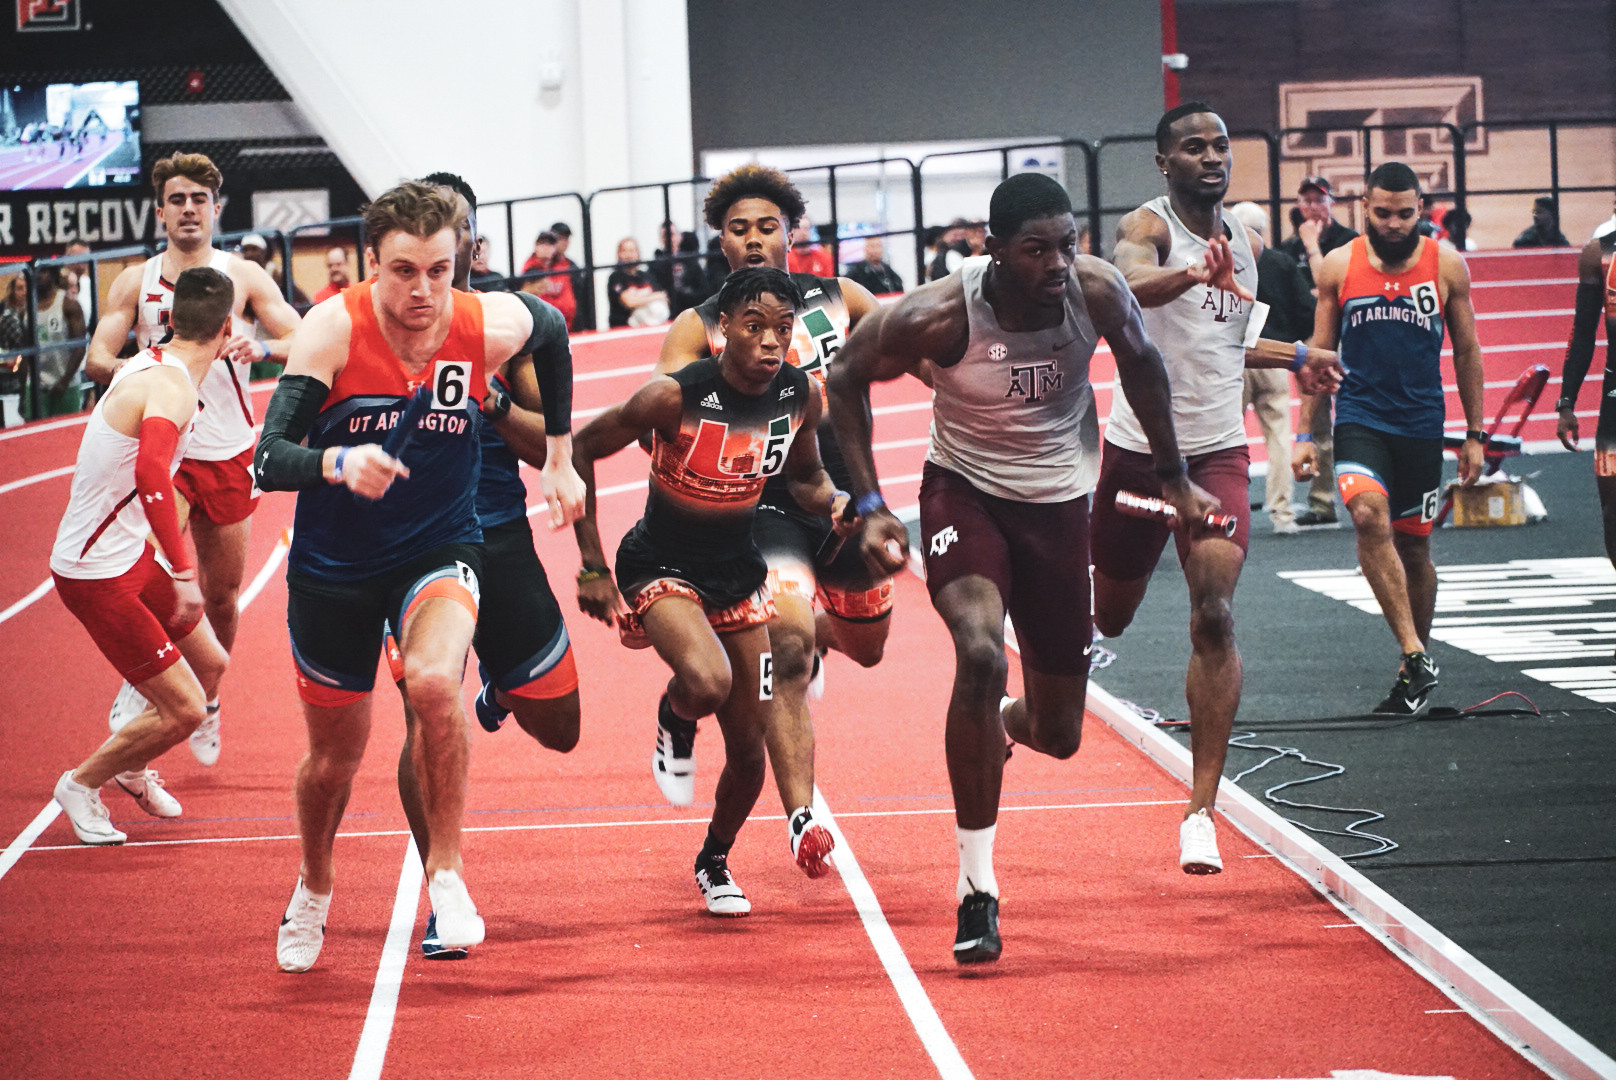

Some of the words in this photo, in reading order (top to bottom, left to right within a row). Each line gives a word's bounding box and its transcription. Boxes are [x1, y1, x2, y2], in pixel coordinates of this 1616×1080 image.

[27, 197, 228, 245] RECOV
[1417, 285, 1436, 315] 6
[1351, 310, 1363, 328] UT
[1365, 306, 1431, 332] ARLINGTON
[988, 343, 1008, 361] SEC
[436, 364, 465, 407] 6
[700, 400, 723, 411] adidas
[350, 415, 372, 434] UT
[374, 410, 468, 435] ARGTON
[762, 437, 785, 475] 5
[1425, 492, 1437, 520] 6
